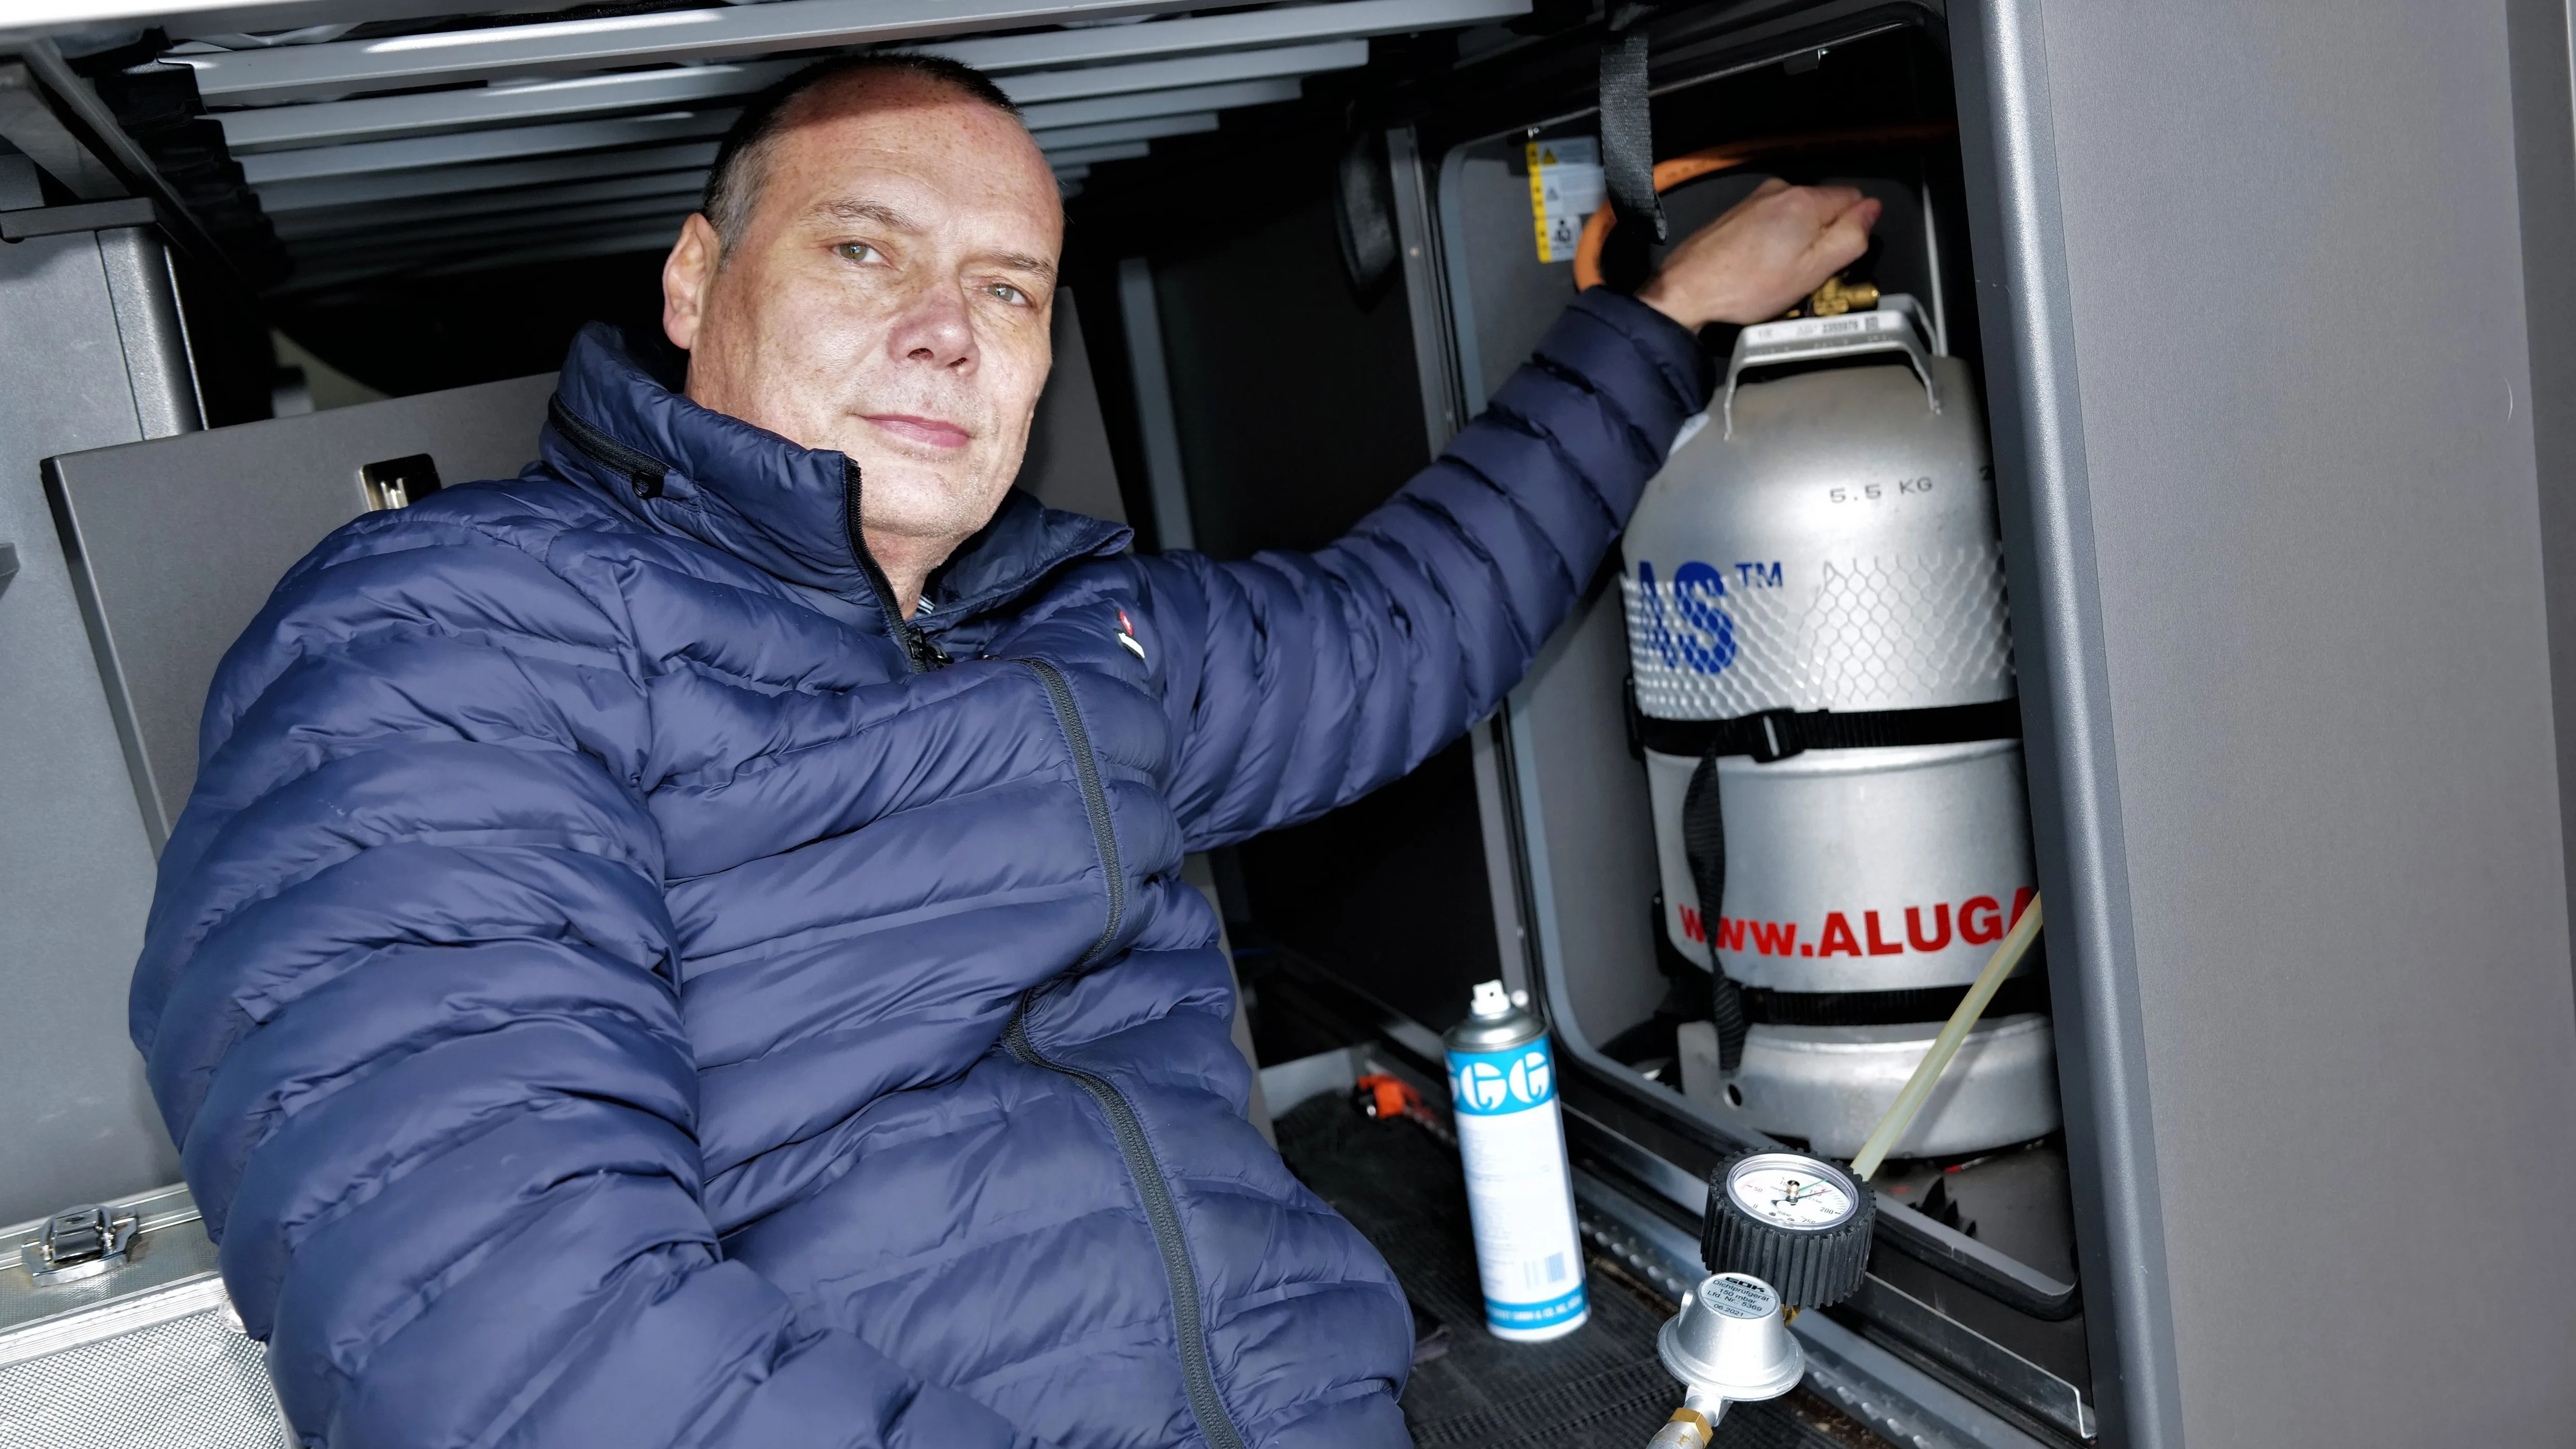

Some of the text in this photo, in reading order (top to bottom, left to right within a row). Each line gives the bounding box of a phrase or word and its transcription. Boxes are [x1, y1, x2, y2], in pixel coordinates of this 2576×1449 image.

[1830, 476, 1933, 503] 5.5 KG
[1820, 1206, 1834, 1215] 200
[1713, 1279, 1770, 1302] Dichtprüfgerät
[1725, 1277, 1766, 1293] GOK
[1707, 1290, 1721, 1299] Lfd.
[1741, 1301, 1763, 1312] 5369
[1719, 1288, 1757, 1304] 150 mbar
[1713, 1303, 1744, 1317] 06.2021
